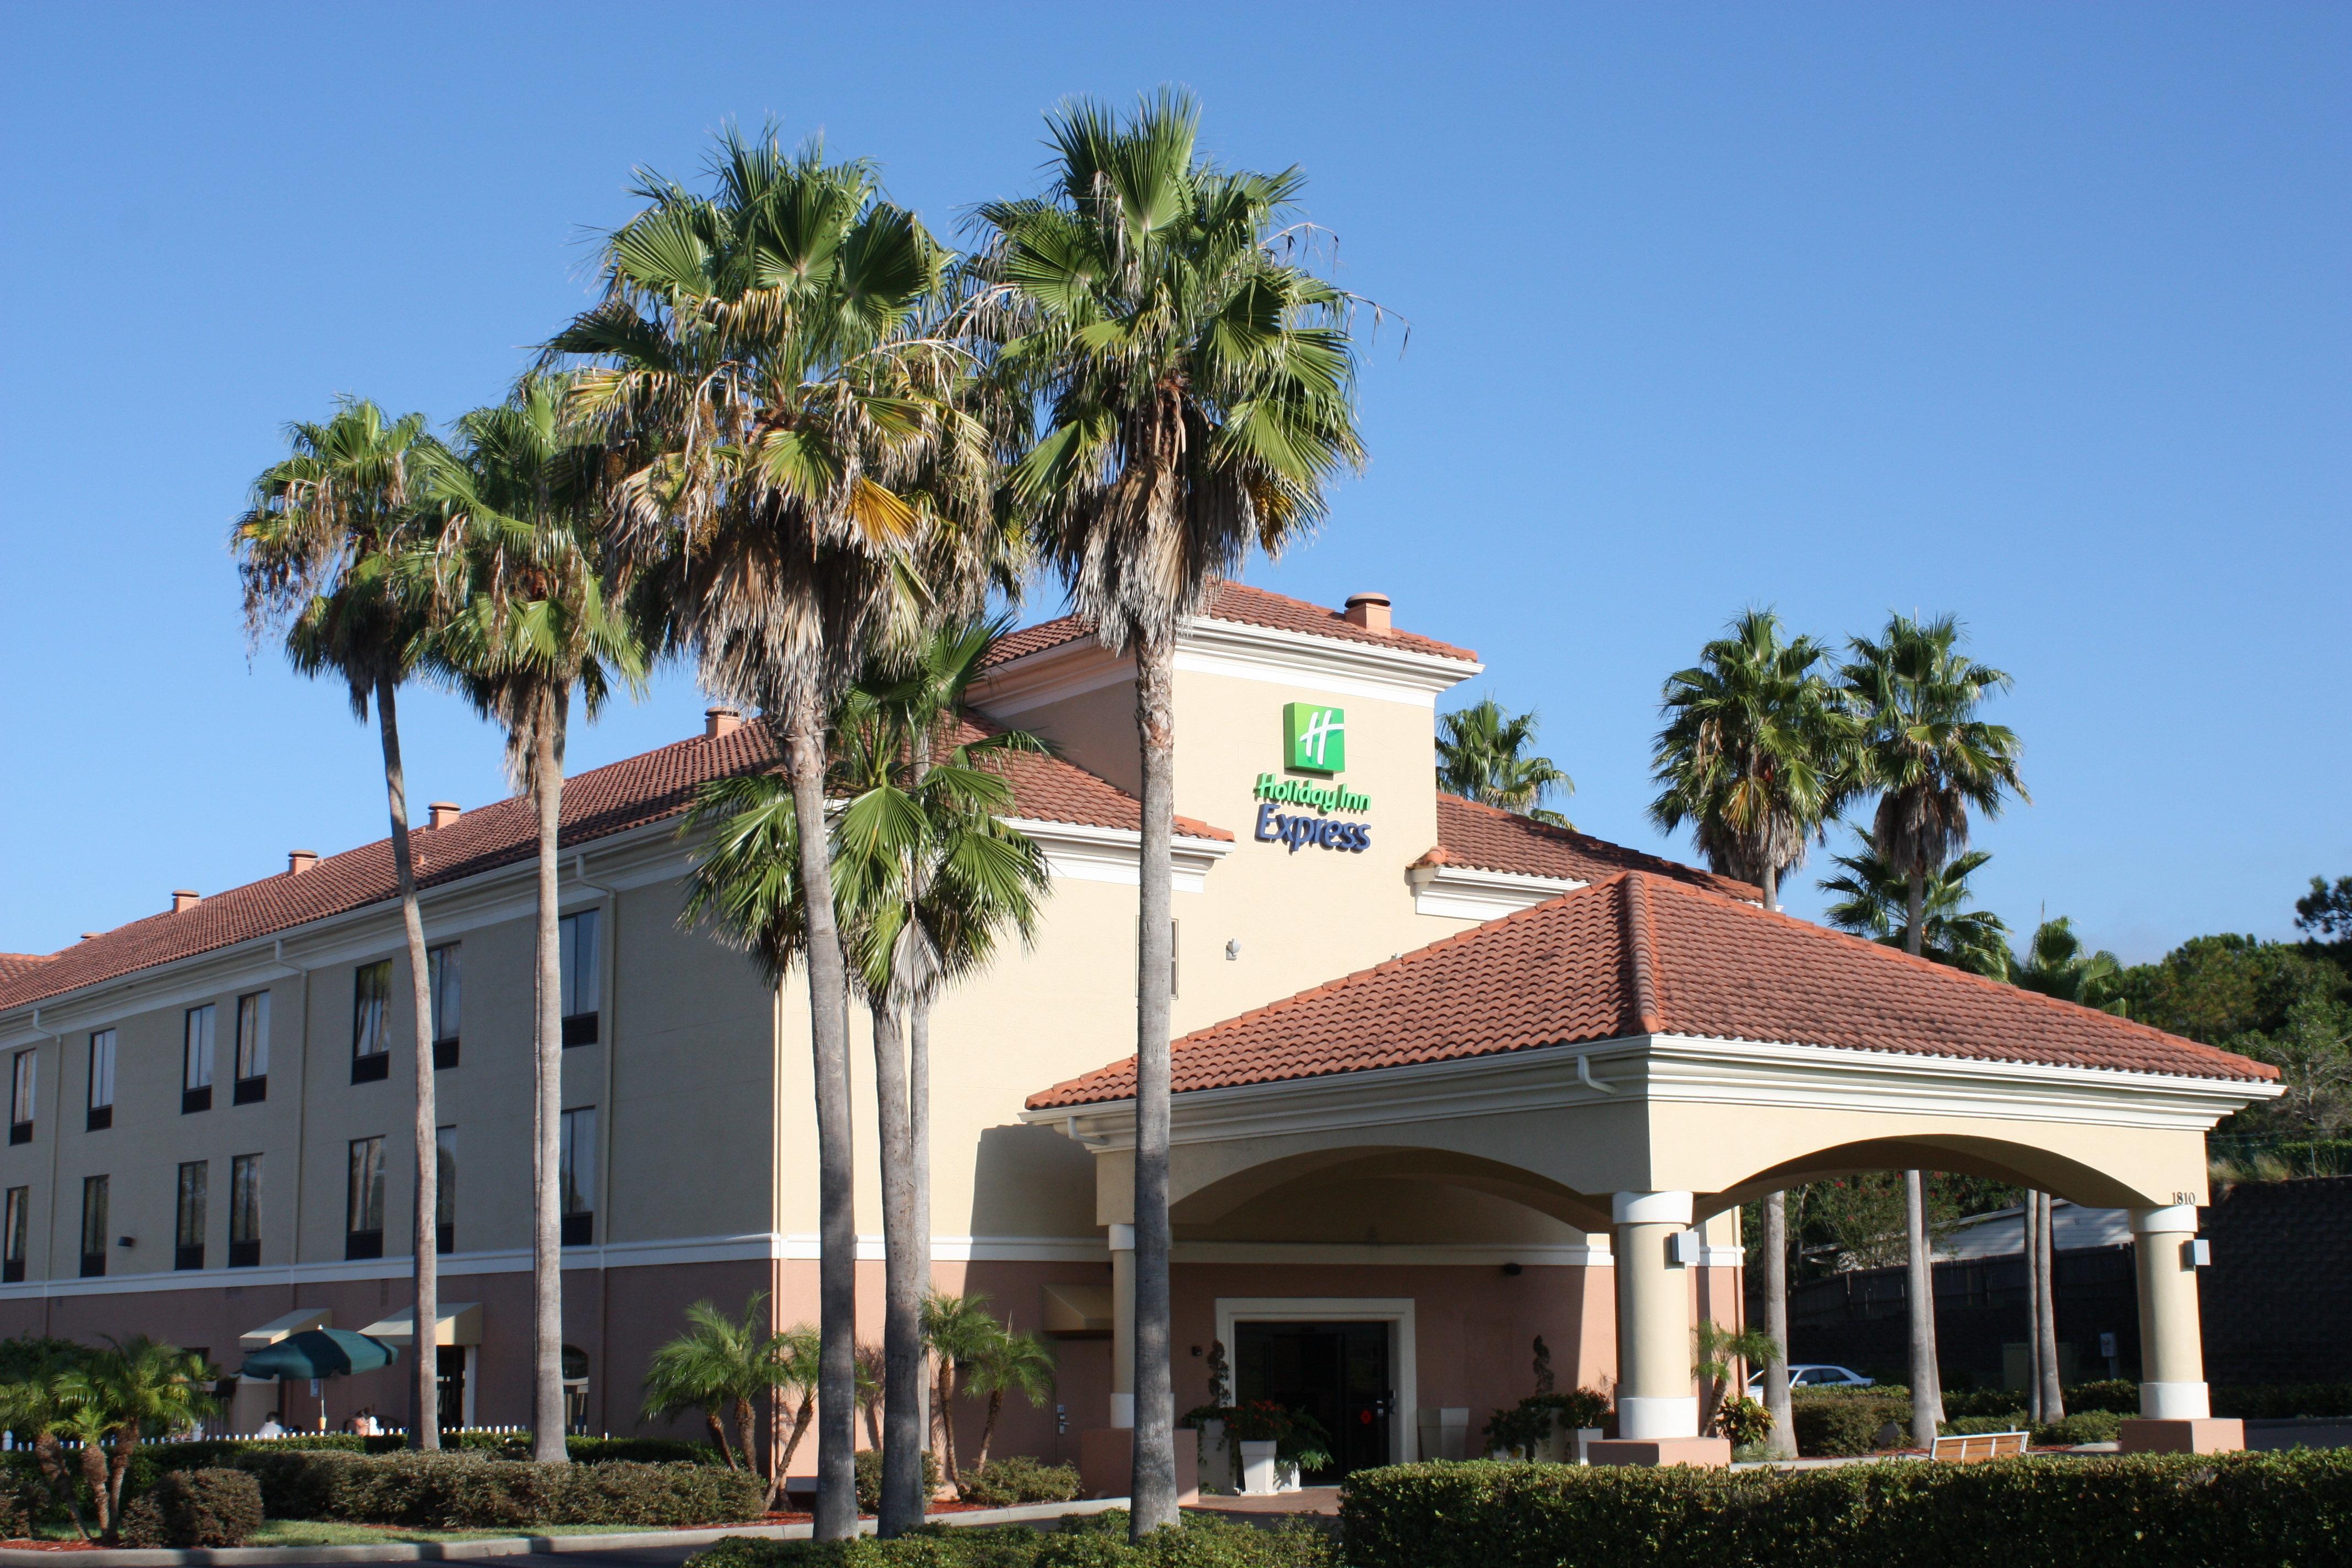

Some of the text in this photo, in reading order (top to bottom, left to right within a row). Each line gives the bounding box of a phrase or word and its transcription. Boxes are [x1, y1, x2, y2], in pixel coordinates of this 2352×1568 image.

[1254, 772, 1371, 812] Holiday Inn
[1255, 803, 1371, 852] Express
[2172, 1191, 2196, 1205] 1810
